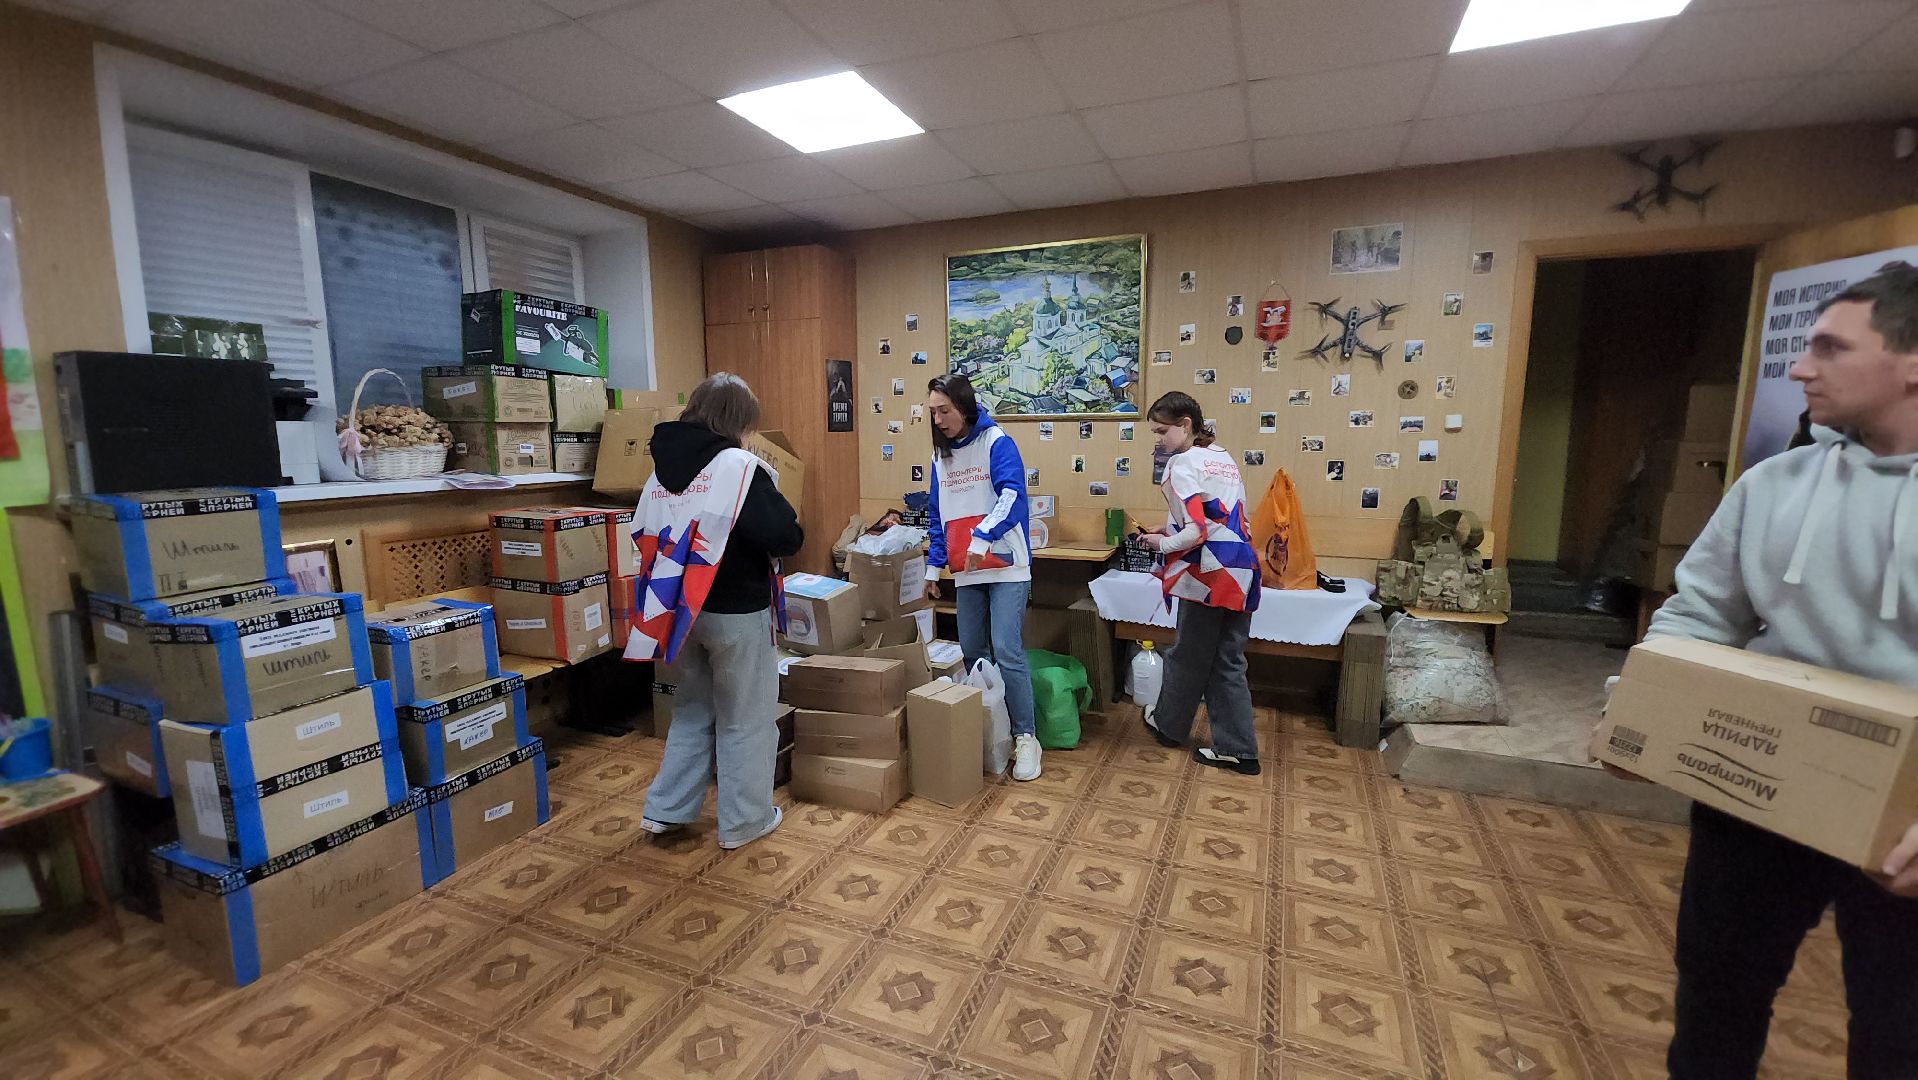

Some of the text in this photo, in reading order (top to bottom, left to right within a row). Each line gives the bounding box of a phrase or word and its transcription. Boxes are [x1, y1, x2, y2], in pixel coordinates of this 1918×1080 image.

[1772, 288, 1796, 308] МОЯ
[514, 304, 568, 321] FAVOURITE
[1769, 310, 1820, 332] МОИ ГЕРО
[1765, 336, 1788, 356] МОЯ
[1763, 358, 1785, 379] МОЙ
[141, 501, 183, 510] РУТЫХ
[240, 585, 276, 599] КРУТЫ
[236, 599, 340, 628] РУТЫХ КРУТЫХ
[1707, 707, 1782, 739] ГРЕЧНЕВАЯ
[1702, 720, 1779, 756] ЯДРИЦА
[521, 741, 543, 756] КРУТЫ
[1676, 752, 1778, 802] Мистраль
